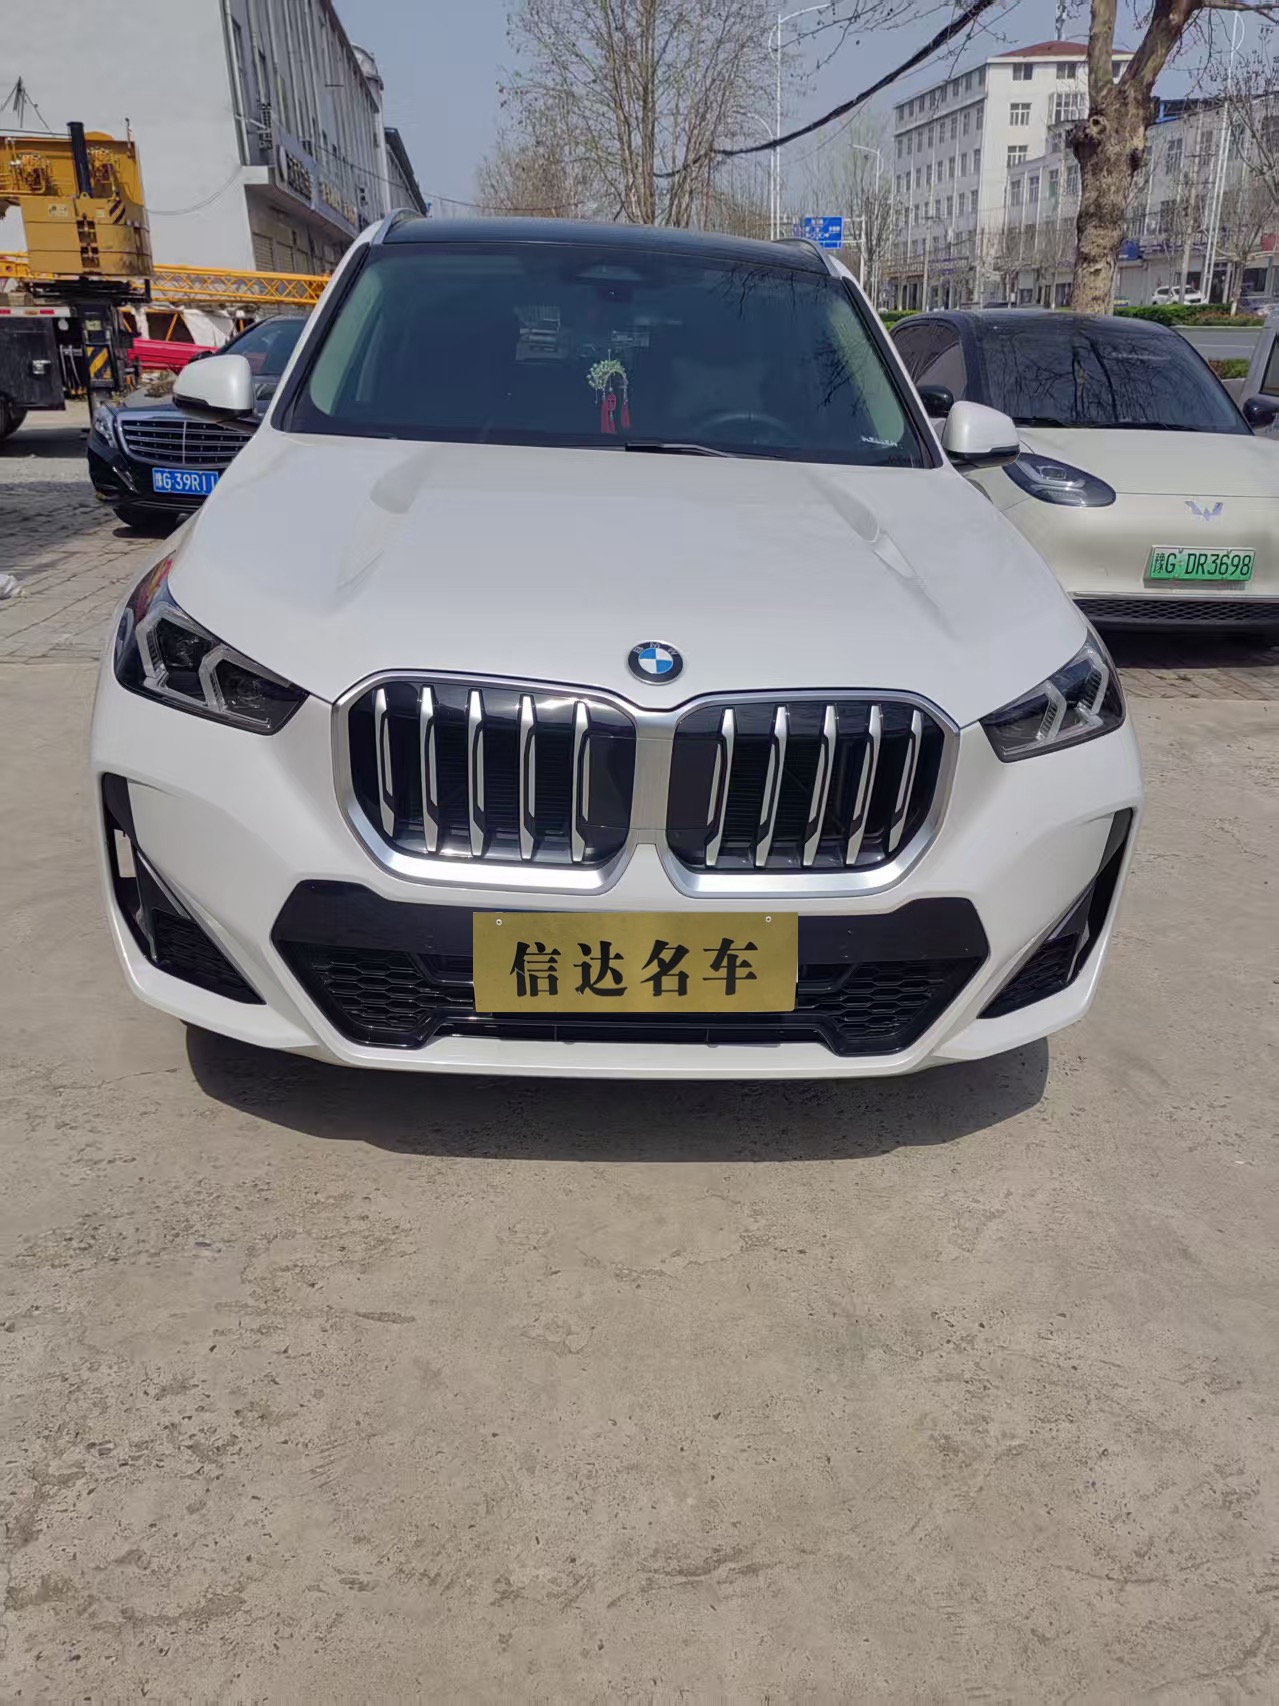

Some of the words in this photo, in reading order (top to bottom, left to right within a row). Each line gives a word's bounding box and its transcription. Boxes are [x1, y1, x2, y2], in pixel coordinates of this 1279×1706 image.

[1184, 553, 1252, 576] DR3698
[633, 643, 678, 655] BMW
[509, 938, 758, 997] 信达名车
